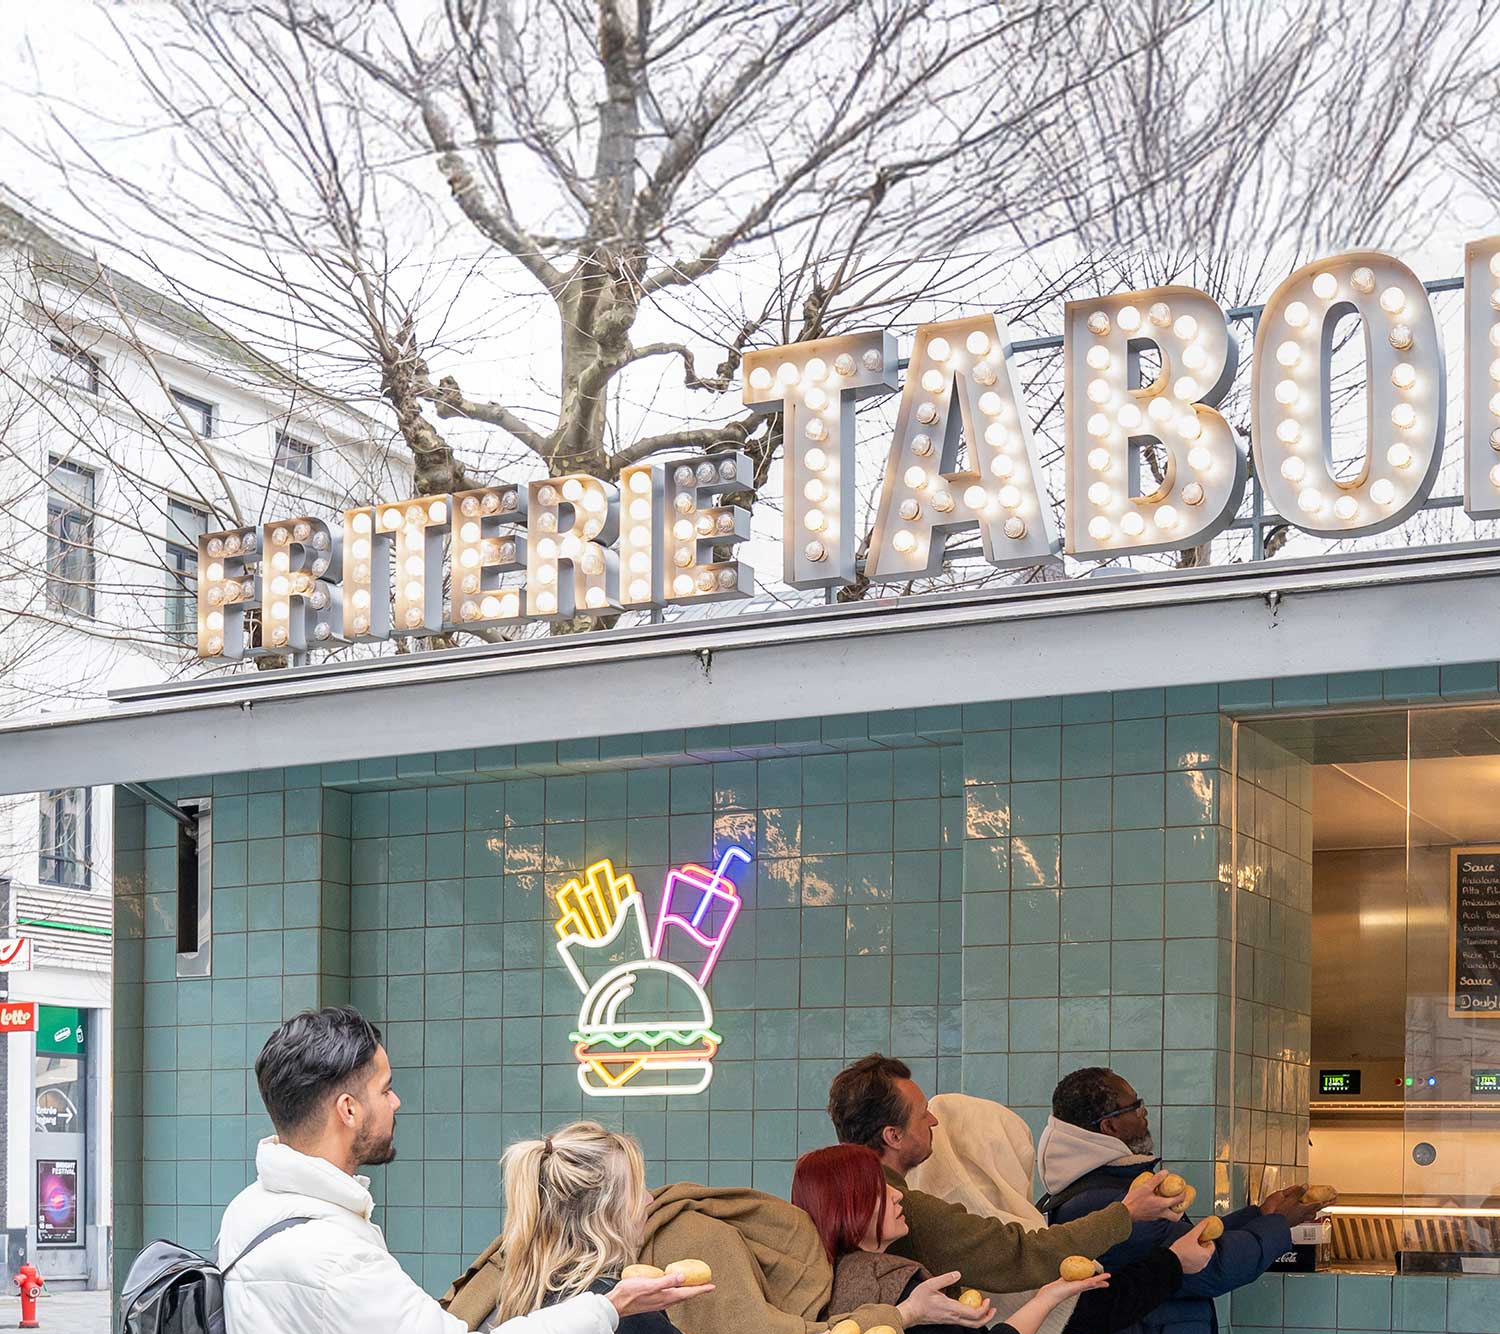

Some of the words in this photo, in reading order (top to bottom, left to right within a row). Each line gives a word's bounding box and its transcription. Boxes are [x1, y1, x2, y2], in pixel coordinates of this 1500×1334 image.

[198, 450, 755, 660] FRITERIE
[1462, 861, 1496, 873] Sauce
[1460, 976, 1493, 986] Sauce
